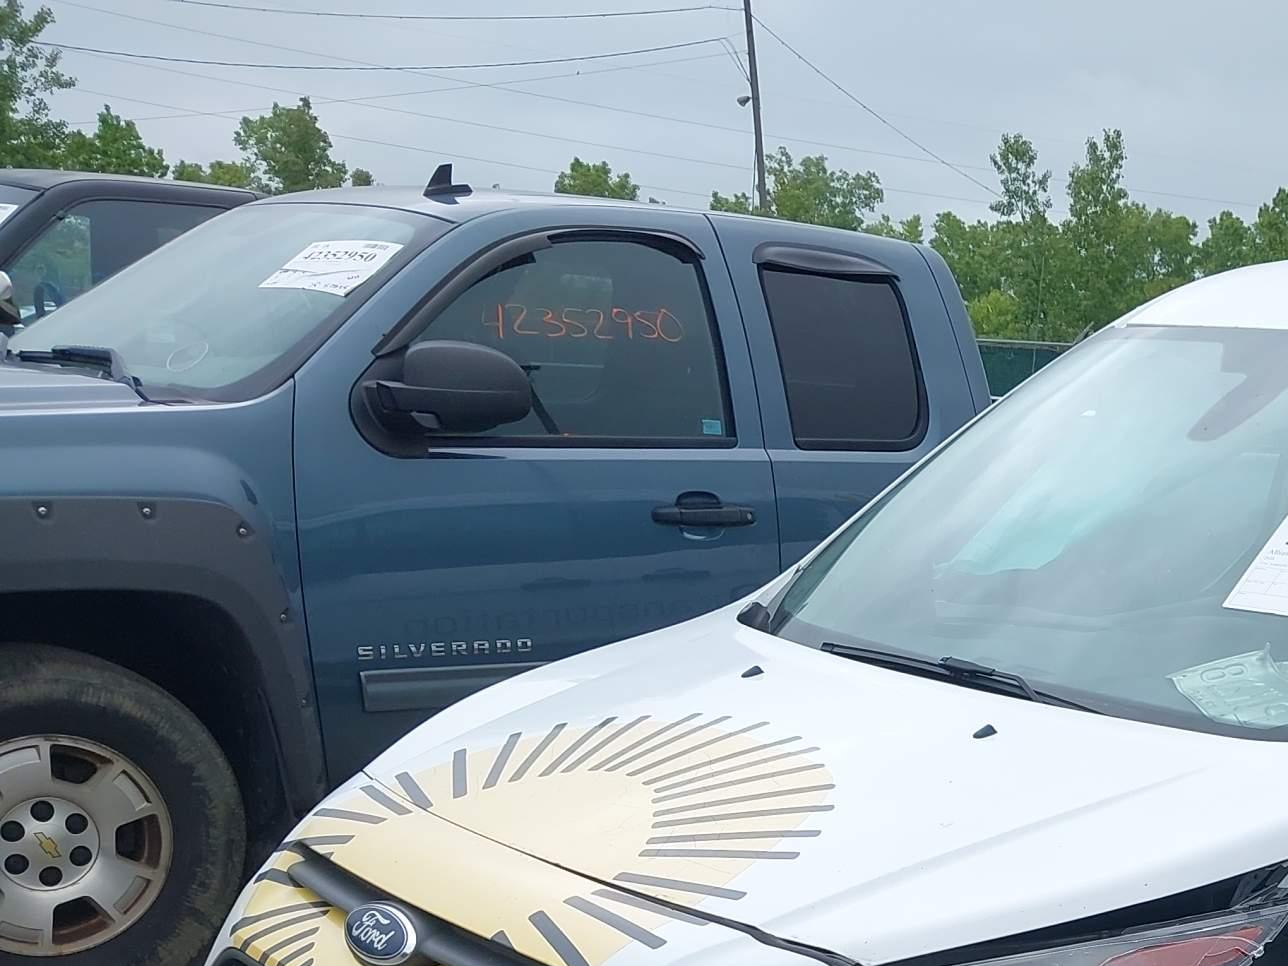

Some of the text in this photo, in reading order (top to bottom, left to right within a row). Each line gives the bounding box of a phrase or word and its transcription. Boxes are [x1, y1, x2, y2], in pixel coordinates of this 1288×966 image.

[482, 304, 685, 342] 42352950
[357, 638, 533, 660] SILVERADO
[352, 911, 396, 950] Ford
